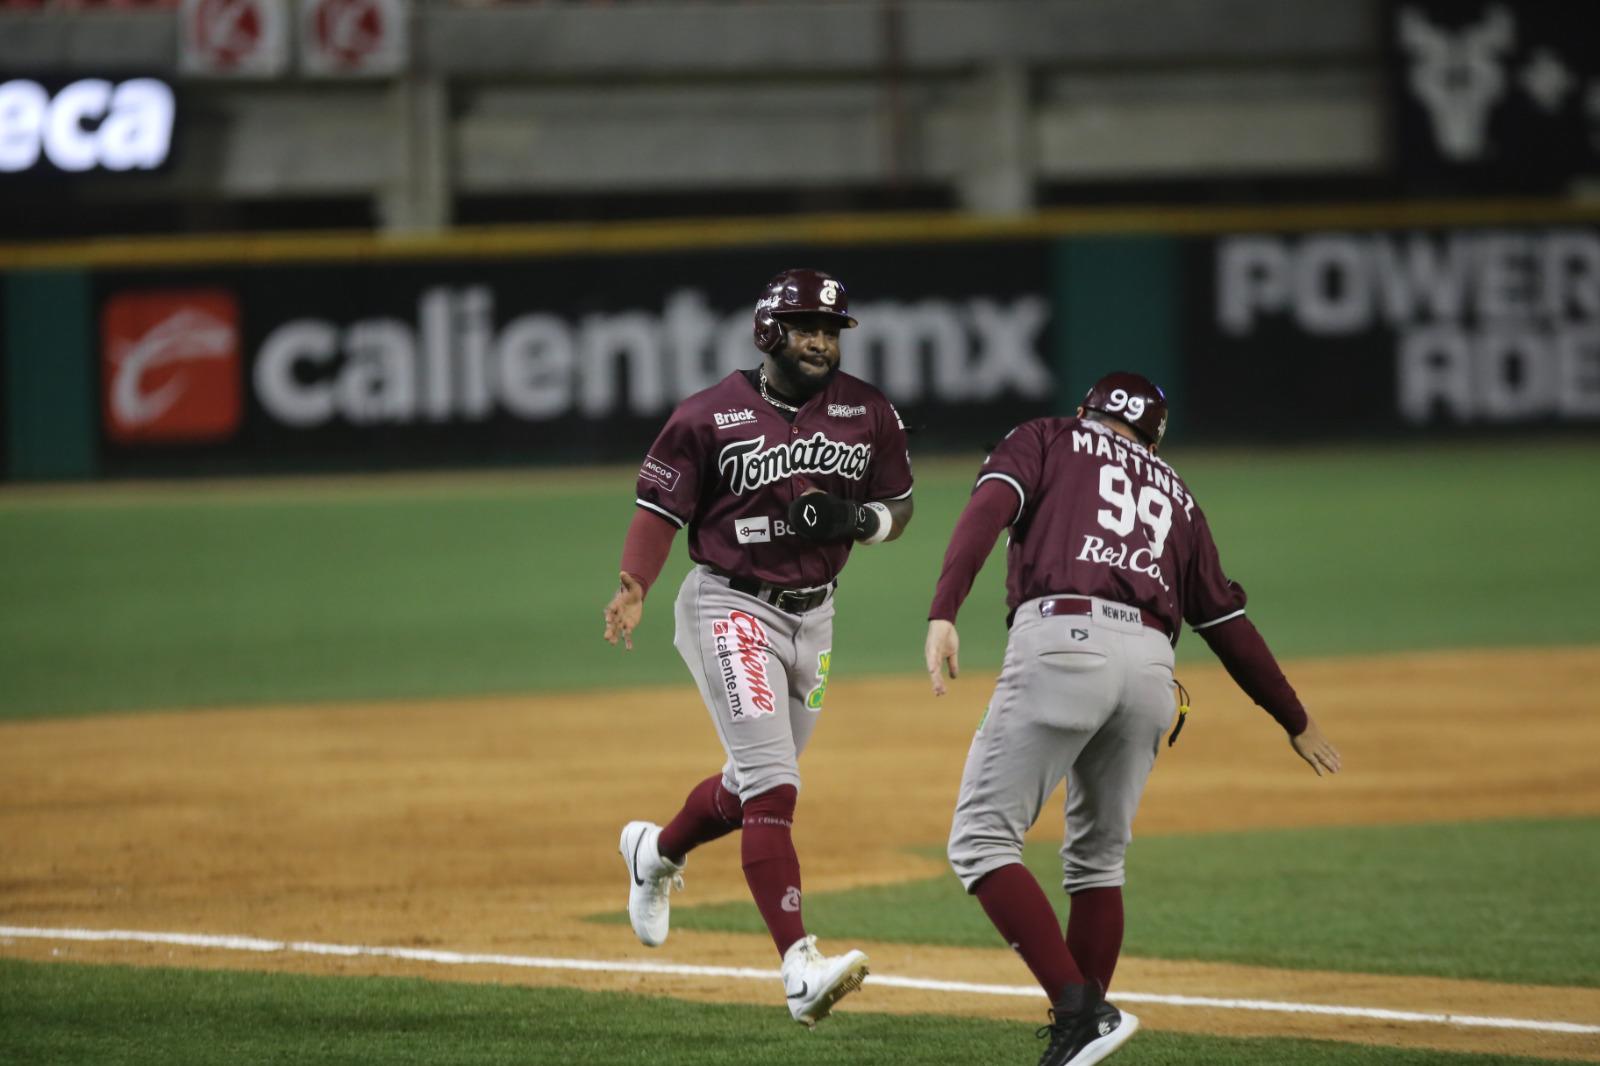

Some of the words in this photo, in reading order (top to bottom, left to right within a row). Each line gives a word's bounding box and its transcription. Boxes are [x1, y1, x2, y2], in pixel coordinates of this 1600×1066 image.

[254, 287, 1052, 424] calientmx
[713, 408, 757, 426] Brück
[1106, 389, 1145, 421] 99
[718, 431, 871, 496] Tomateros
[1072, 430, 1194, 522] MARTINEZ
[1097, 463, 1173, 559] 99
[716, 635, 744, 718] caliente.mx
